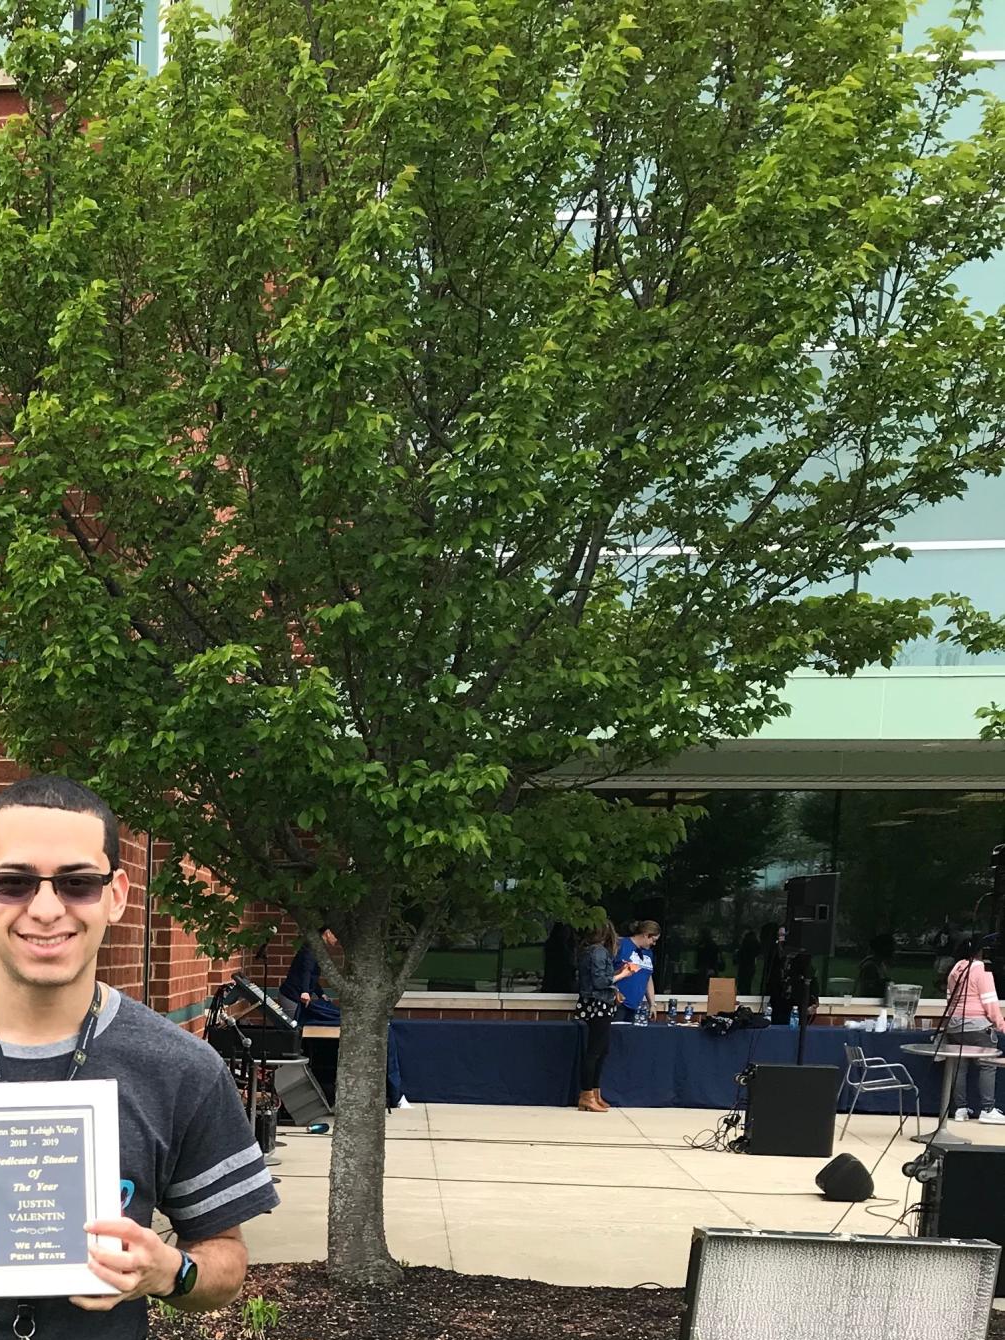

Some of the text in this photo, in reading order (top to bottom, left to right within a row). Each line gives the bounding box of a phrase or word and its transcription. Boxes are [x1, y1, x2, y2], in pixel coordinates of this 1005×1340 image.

[10, 1126, 28, 1135] State
[30, 1126, 55, 1137] Lehigh
[56, 1125, 79, 1136] Valley
[10, 1139, 27, 1147] 2018
[41, 1138, 59, 1146] 2019
[42, 1155, 78, 1164] Student
[28, 1169, 43, 1180] Of
[13, 1182, 59, 1192] The Year
[17, 1199, 55, 1211] JUSTIN
[8, 1212, 66, 1222] VALENTIN
